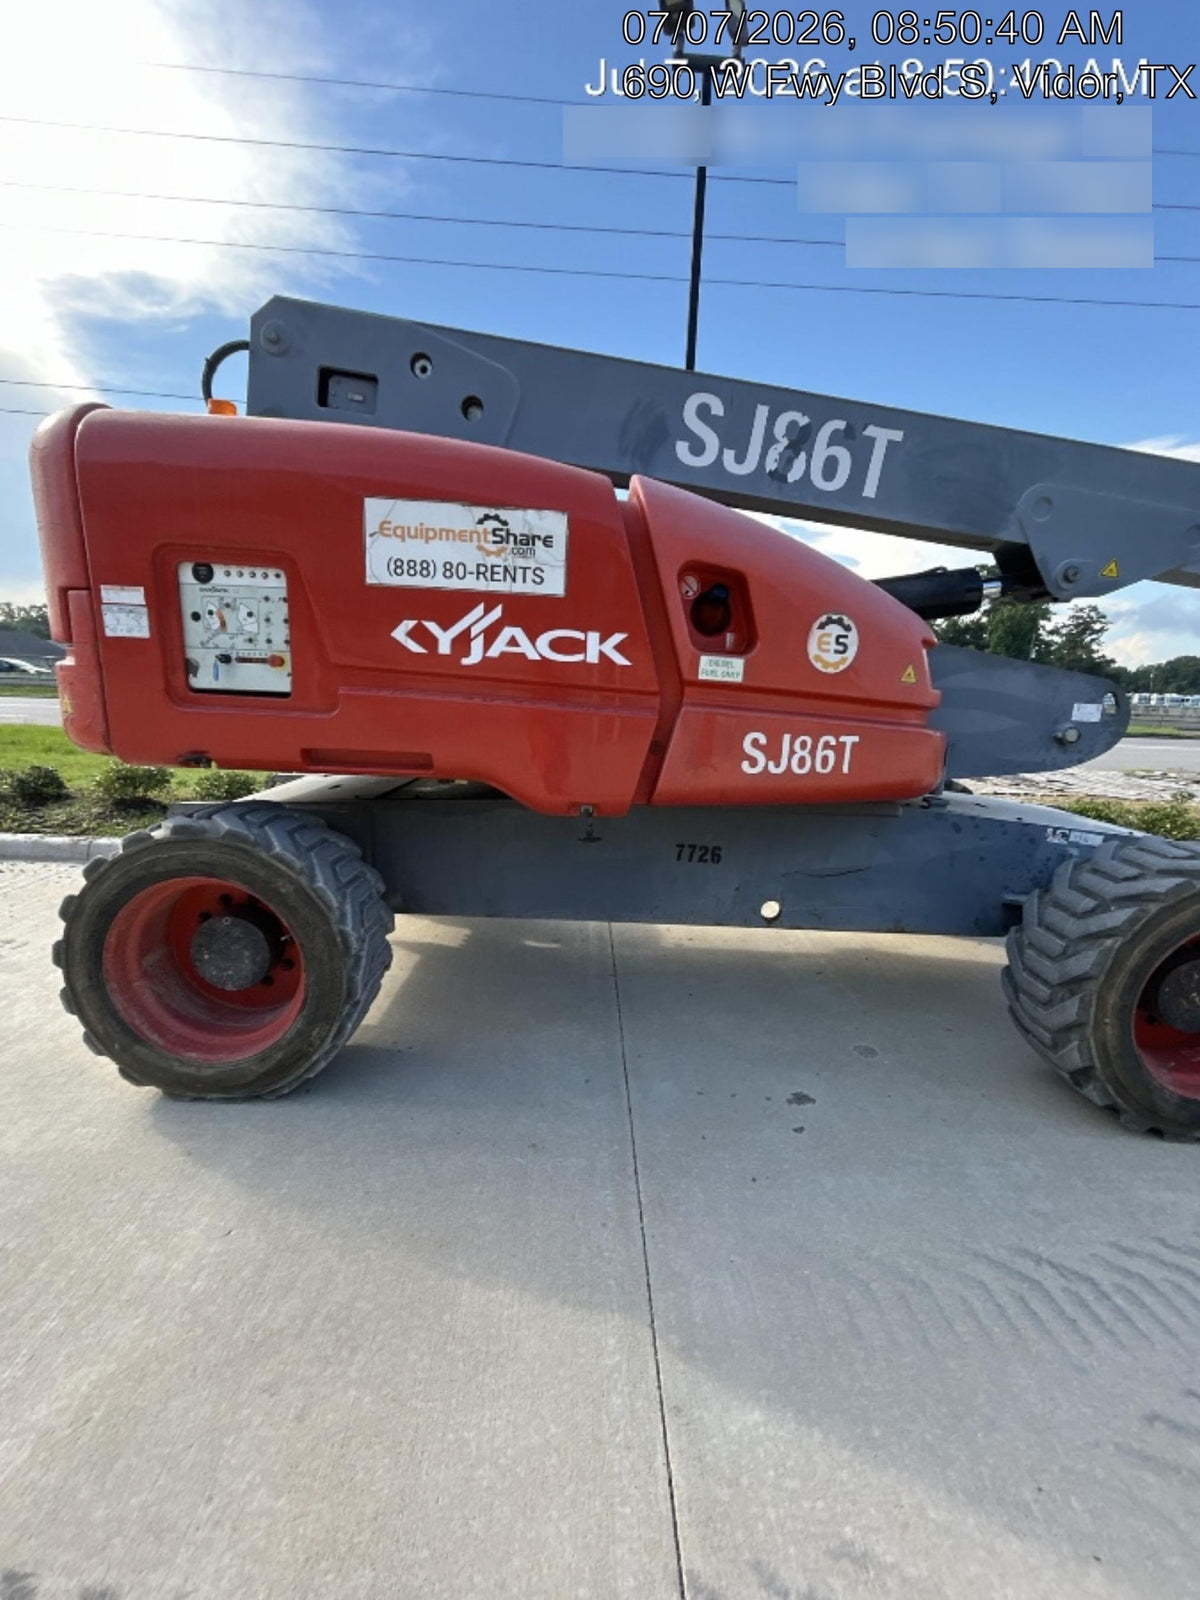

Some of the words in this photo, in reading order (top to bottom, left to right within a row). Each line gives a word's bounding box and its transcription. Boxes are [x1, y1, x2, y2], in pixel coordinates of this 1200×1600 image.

[675, 391, 904, 499] SJ86T
[379, 519, 554, 549] EquipmentShare
[386, 556, 437, 580] (888)
[442, 561, 546, 586] 80-RENTS
[817, 633, 850, 655] ES
[740, 731, 860, 775] SJ86T
[675, 844, 722, 864] 7726
